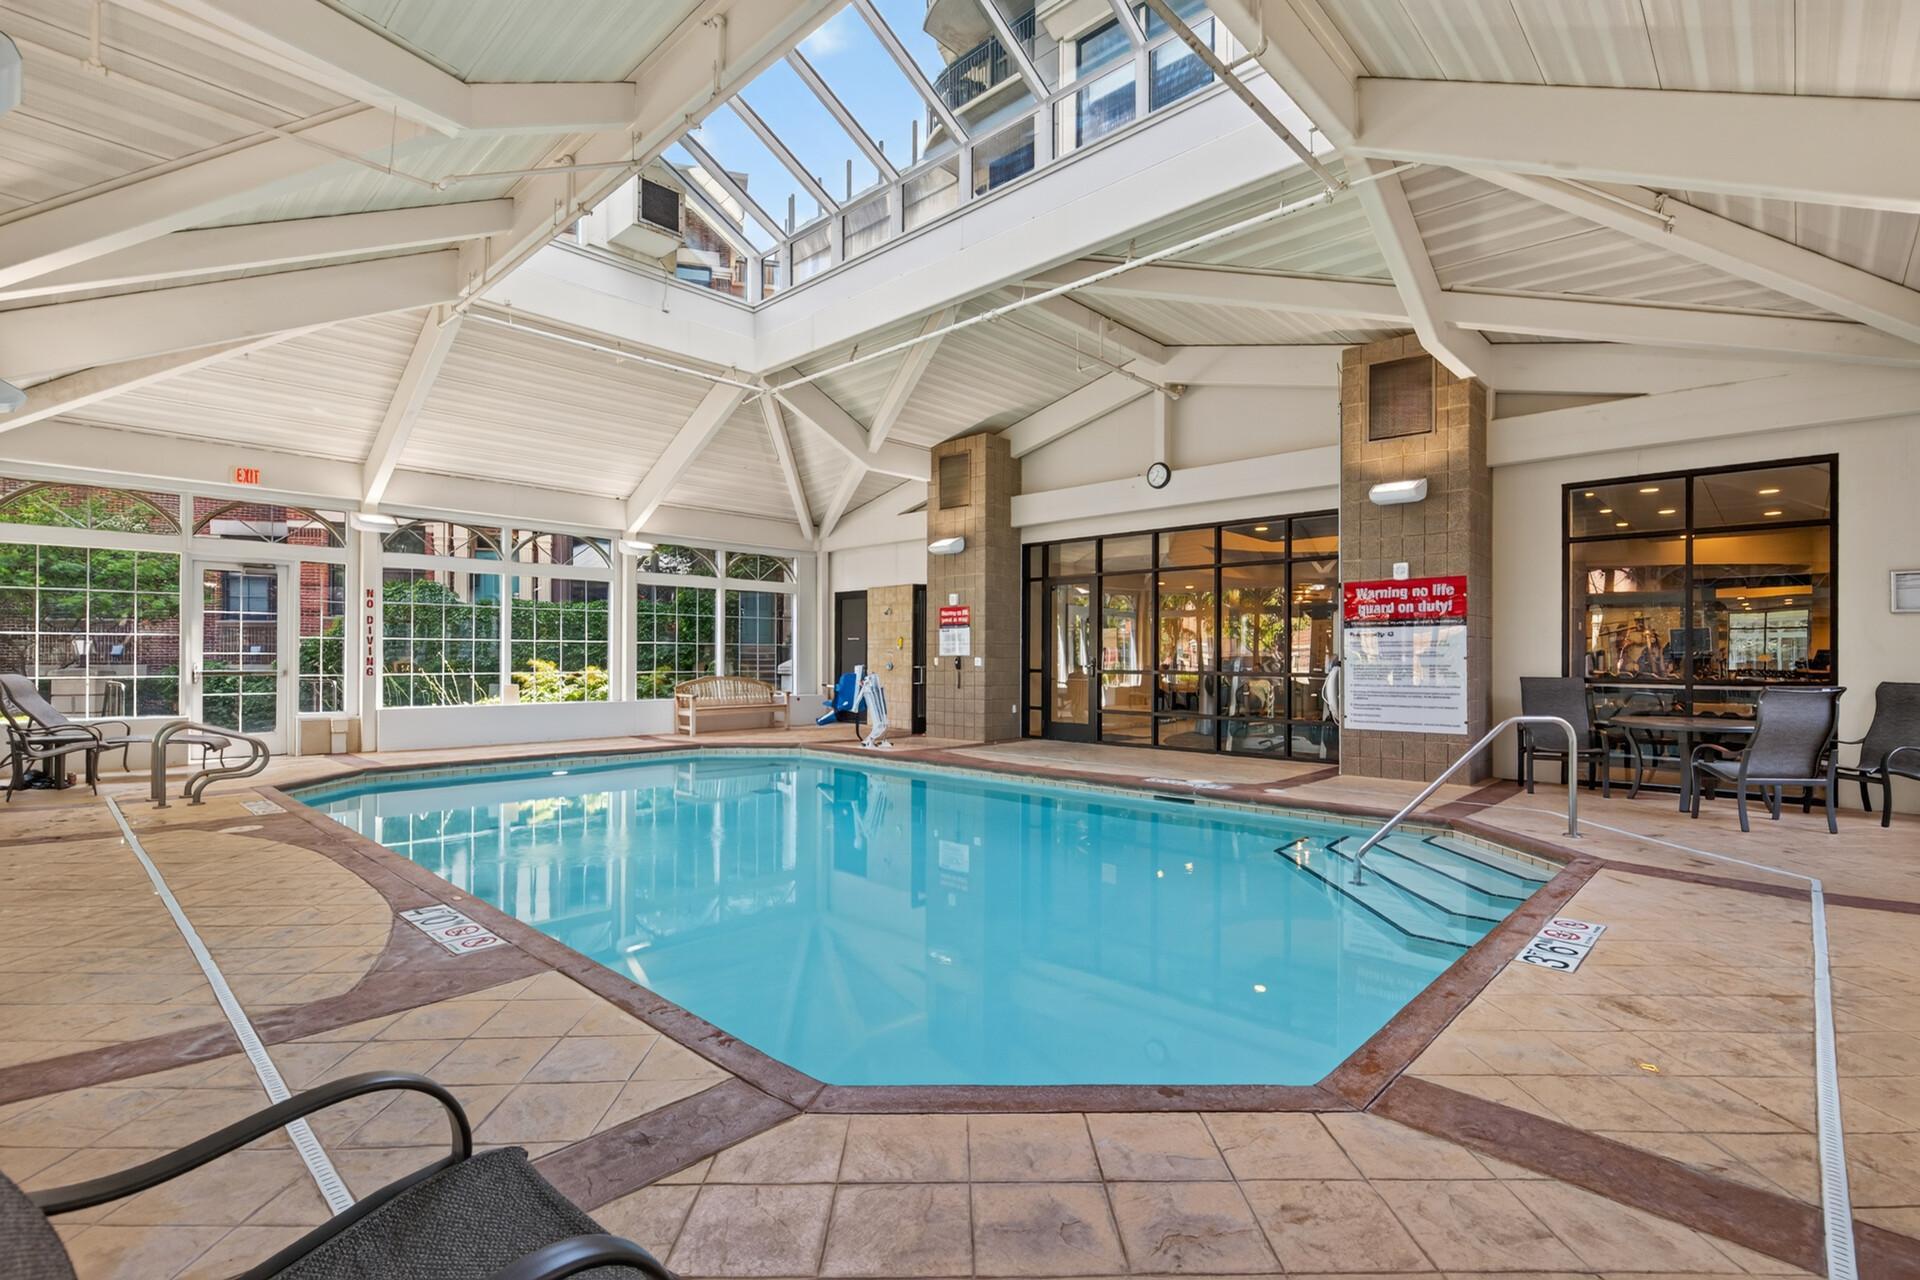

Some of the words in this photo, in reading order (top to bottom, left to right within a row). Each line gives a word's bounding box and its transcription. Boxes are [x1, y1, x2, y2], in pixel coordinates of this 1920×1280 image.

[236, 467, 260, 484] EXIT
[366, 589, 374, 608] NO
[1355, 586, 1408, 600] Warning
[1412, 587, 1429, 597] no
[1432, 583, 1455, 596] life
[1358, 602, 1395, 616] guard
[1397, 603, 1414, 613] on
[1418, 600, 1453, 616] duty!
[366, 616, 374, 676] DIVING
[1534, 943, 1579, 956] 6
[1522, 955, 1570, 969] 3
